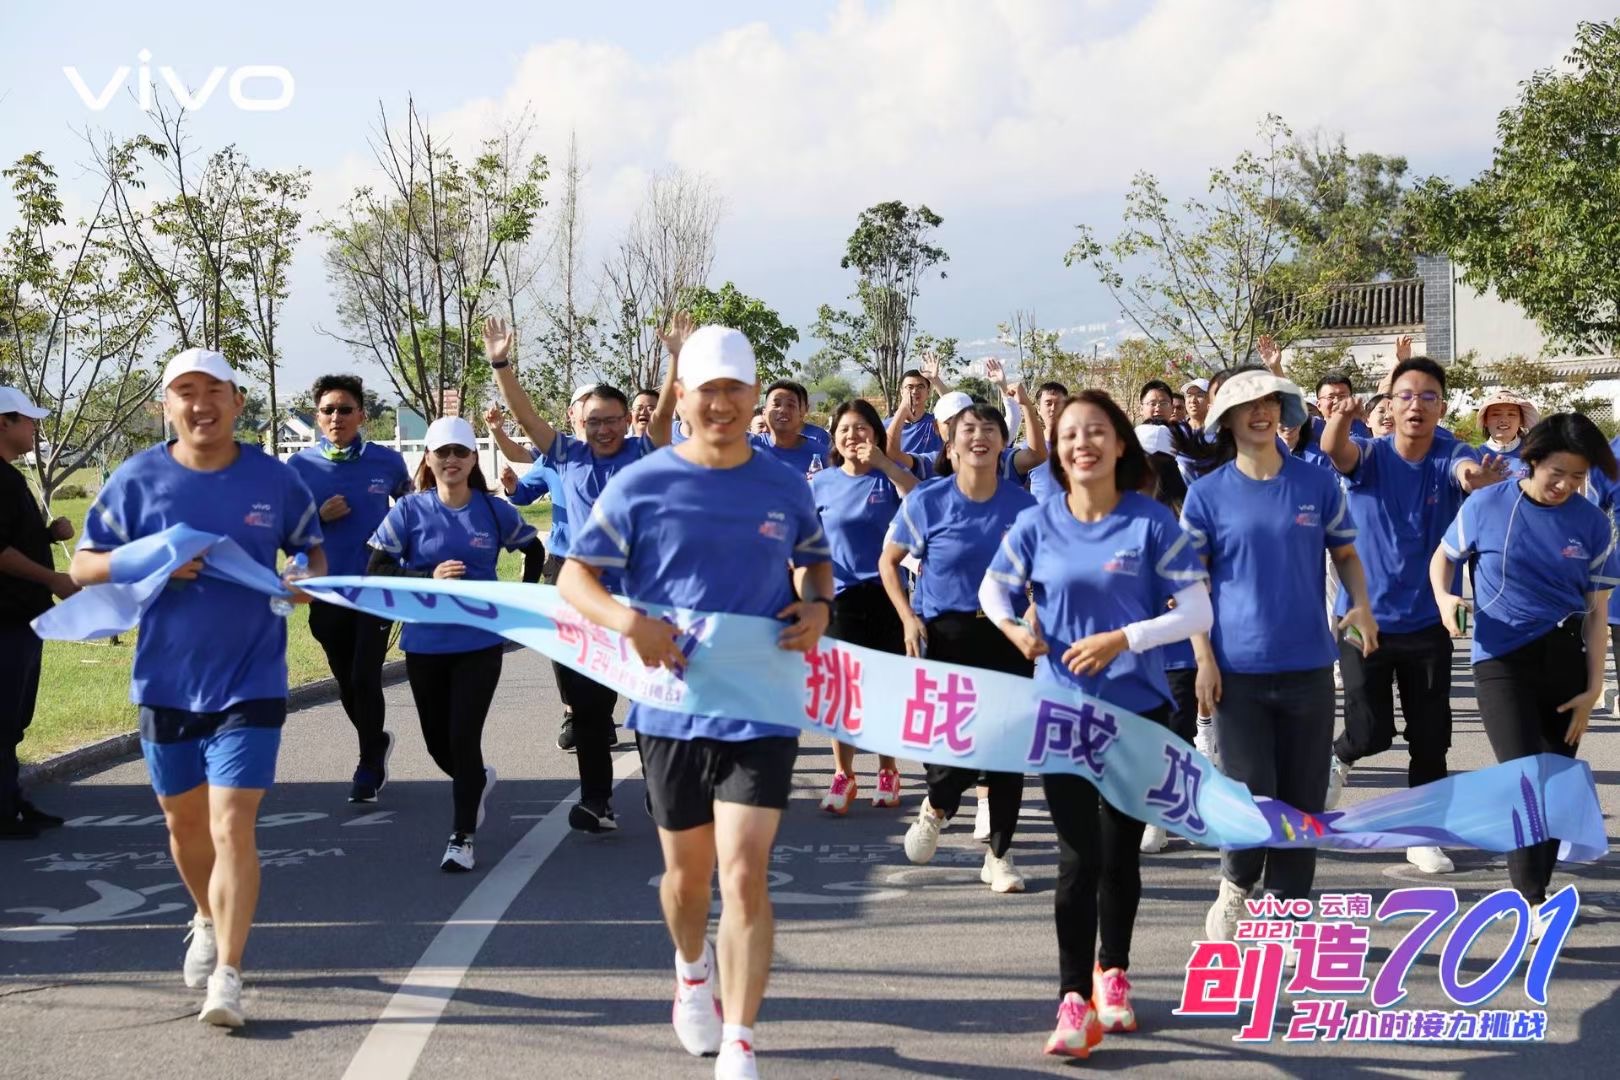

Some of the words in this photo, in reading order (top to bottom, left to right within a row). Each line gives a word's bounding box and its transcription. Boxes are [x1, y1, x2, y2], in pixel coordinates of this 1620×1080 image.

[803, 646, 1208, 835] 挑战成功
[24, 847, 347, 862] WAWAY
